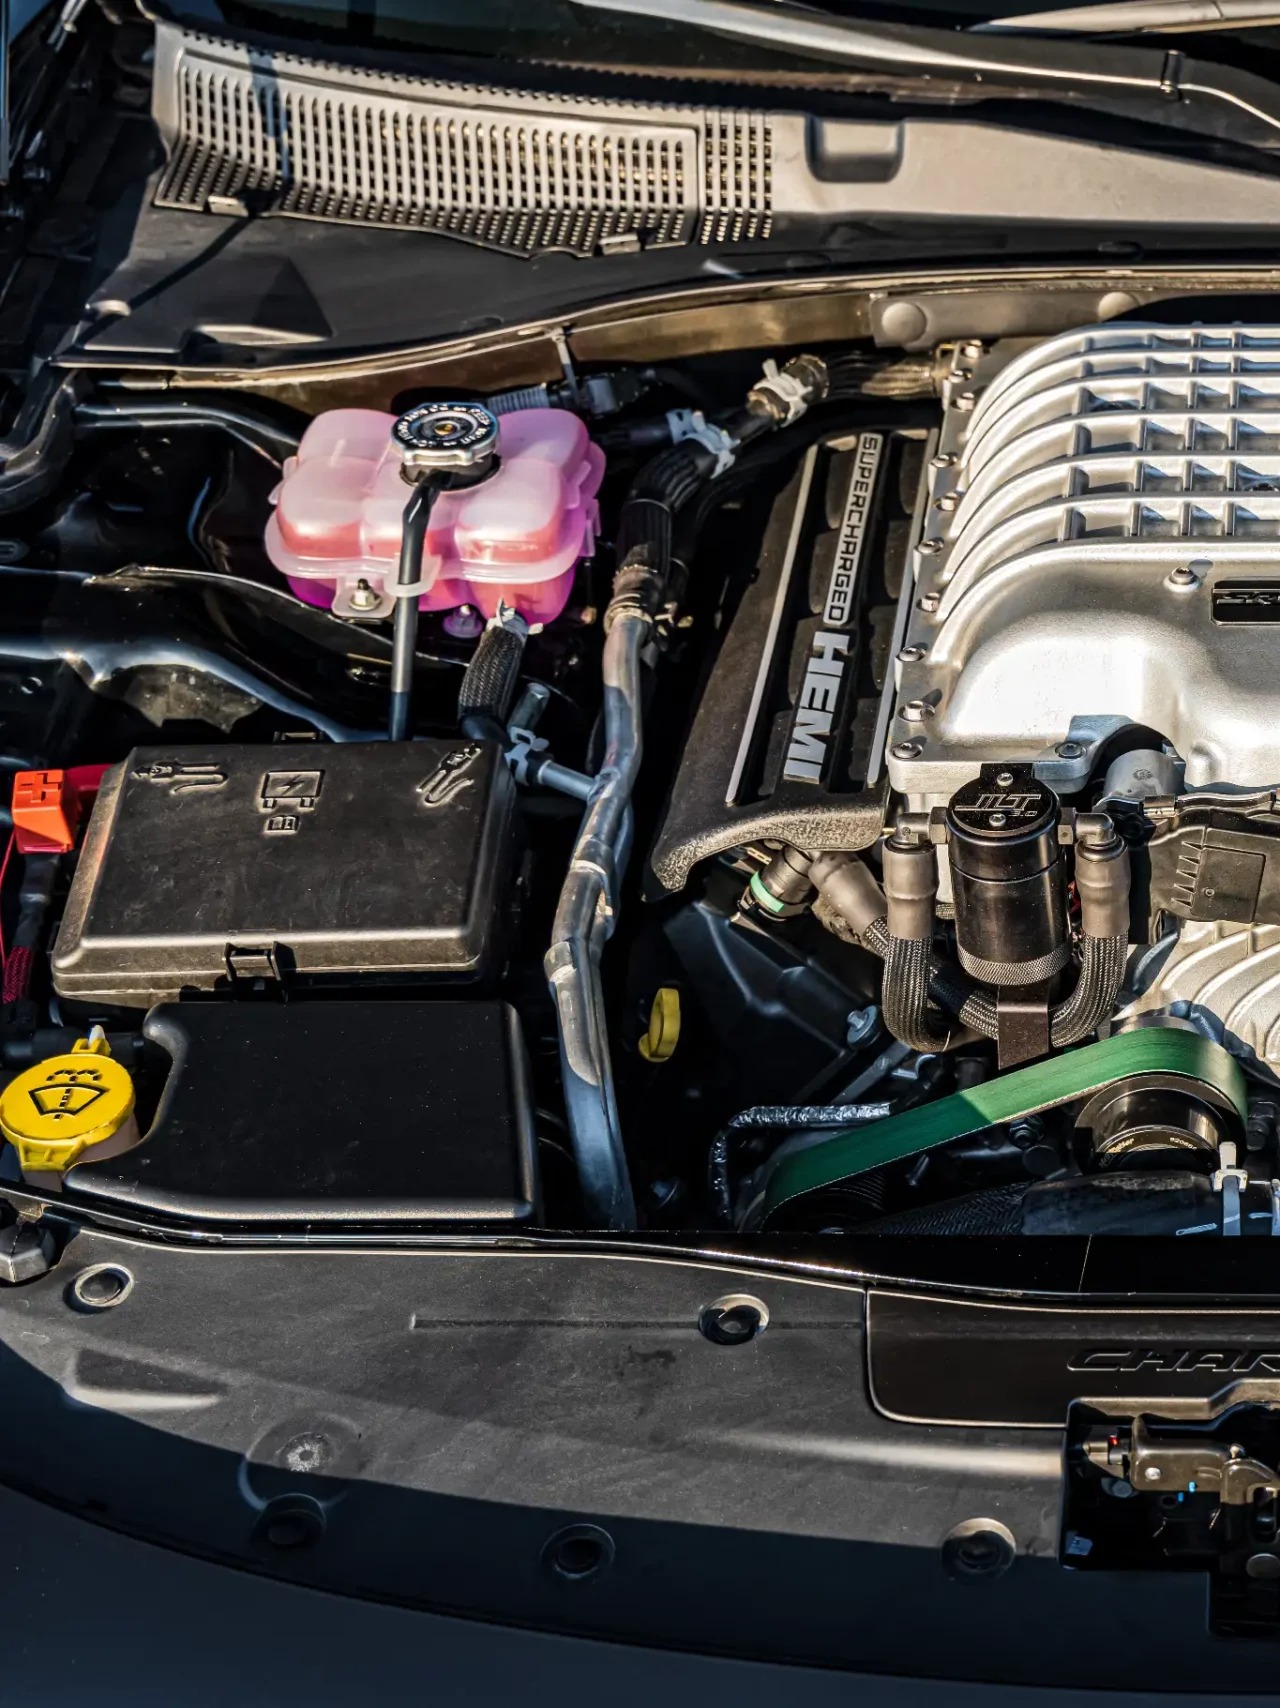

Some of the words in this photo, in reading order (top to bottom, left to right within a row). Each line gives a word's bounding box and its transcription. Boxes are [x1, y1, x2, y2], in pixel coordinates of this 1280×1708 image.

[827, 436, 879, 623] SUPERCHARGED
[783, 631, 850, 784] HEMI
[954, 794, 1041, 811] JLT
